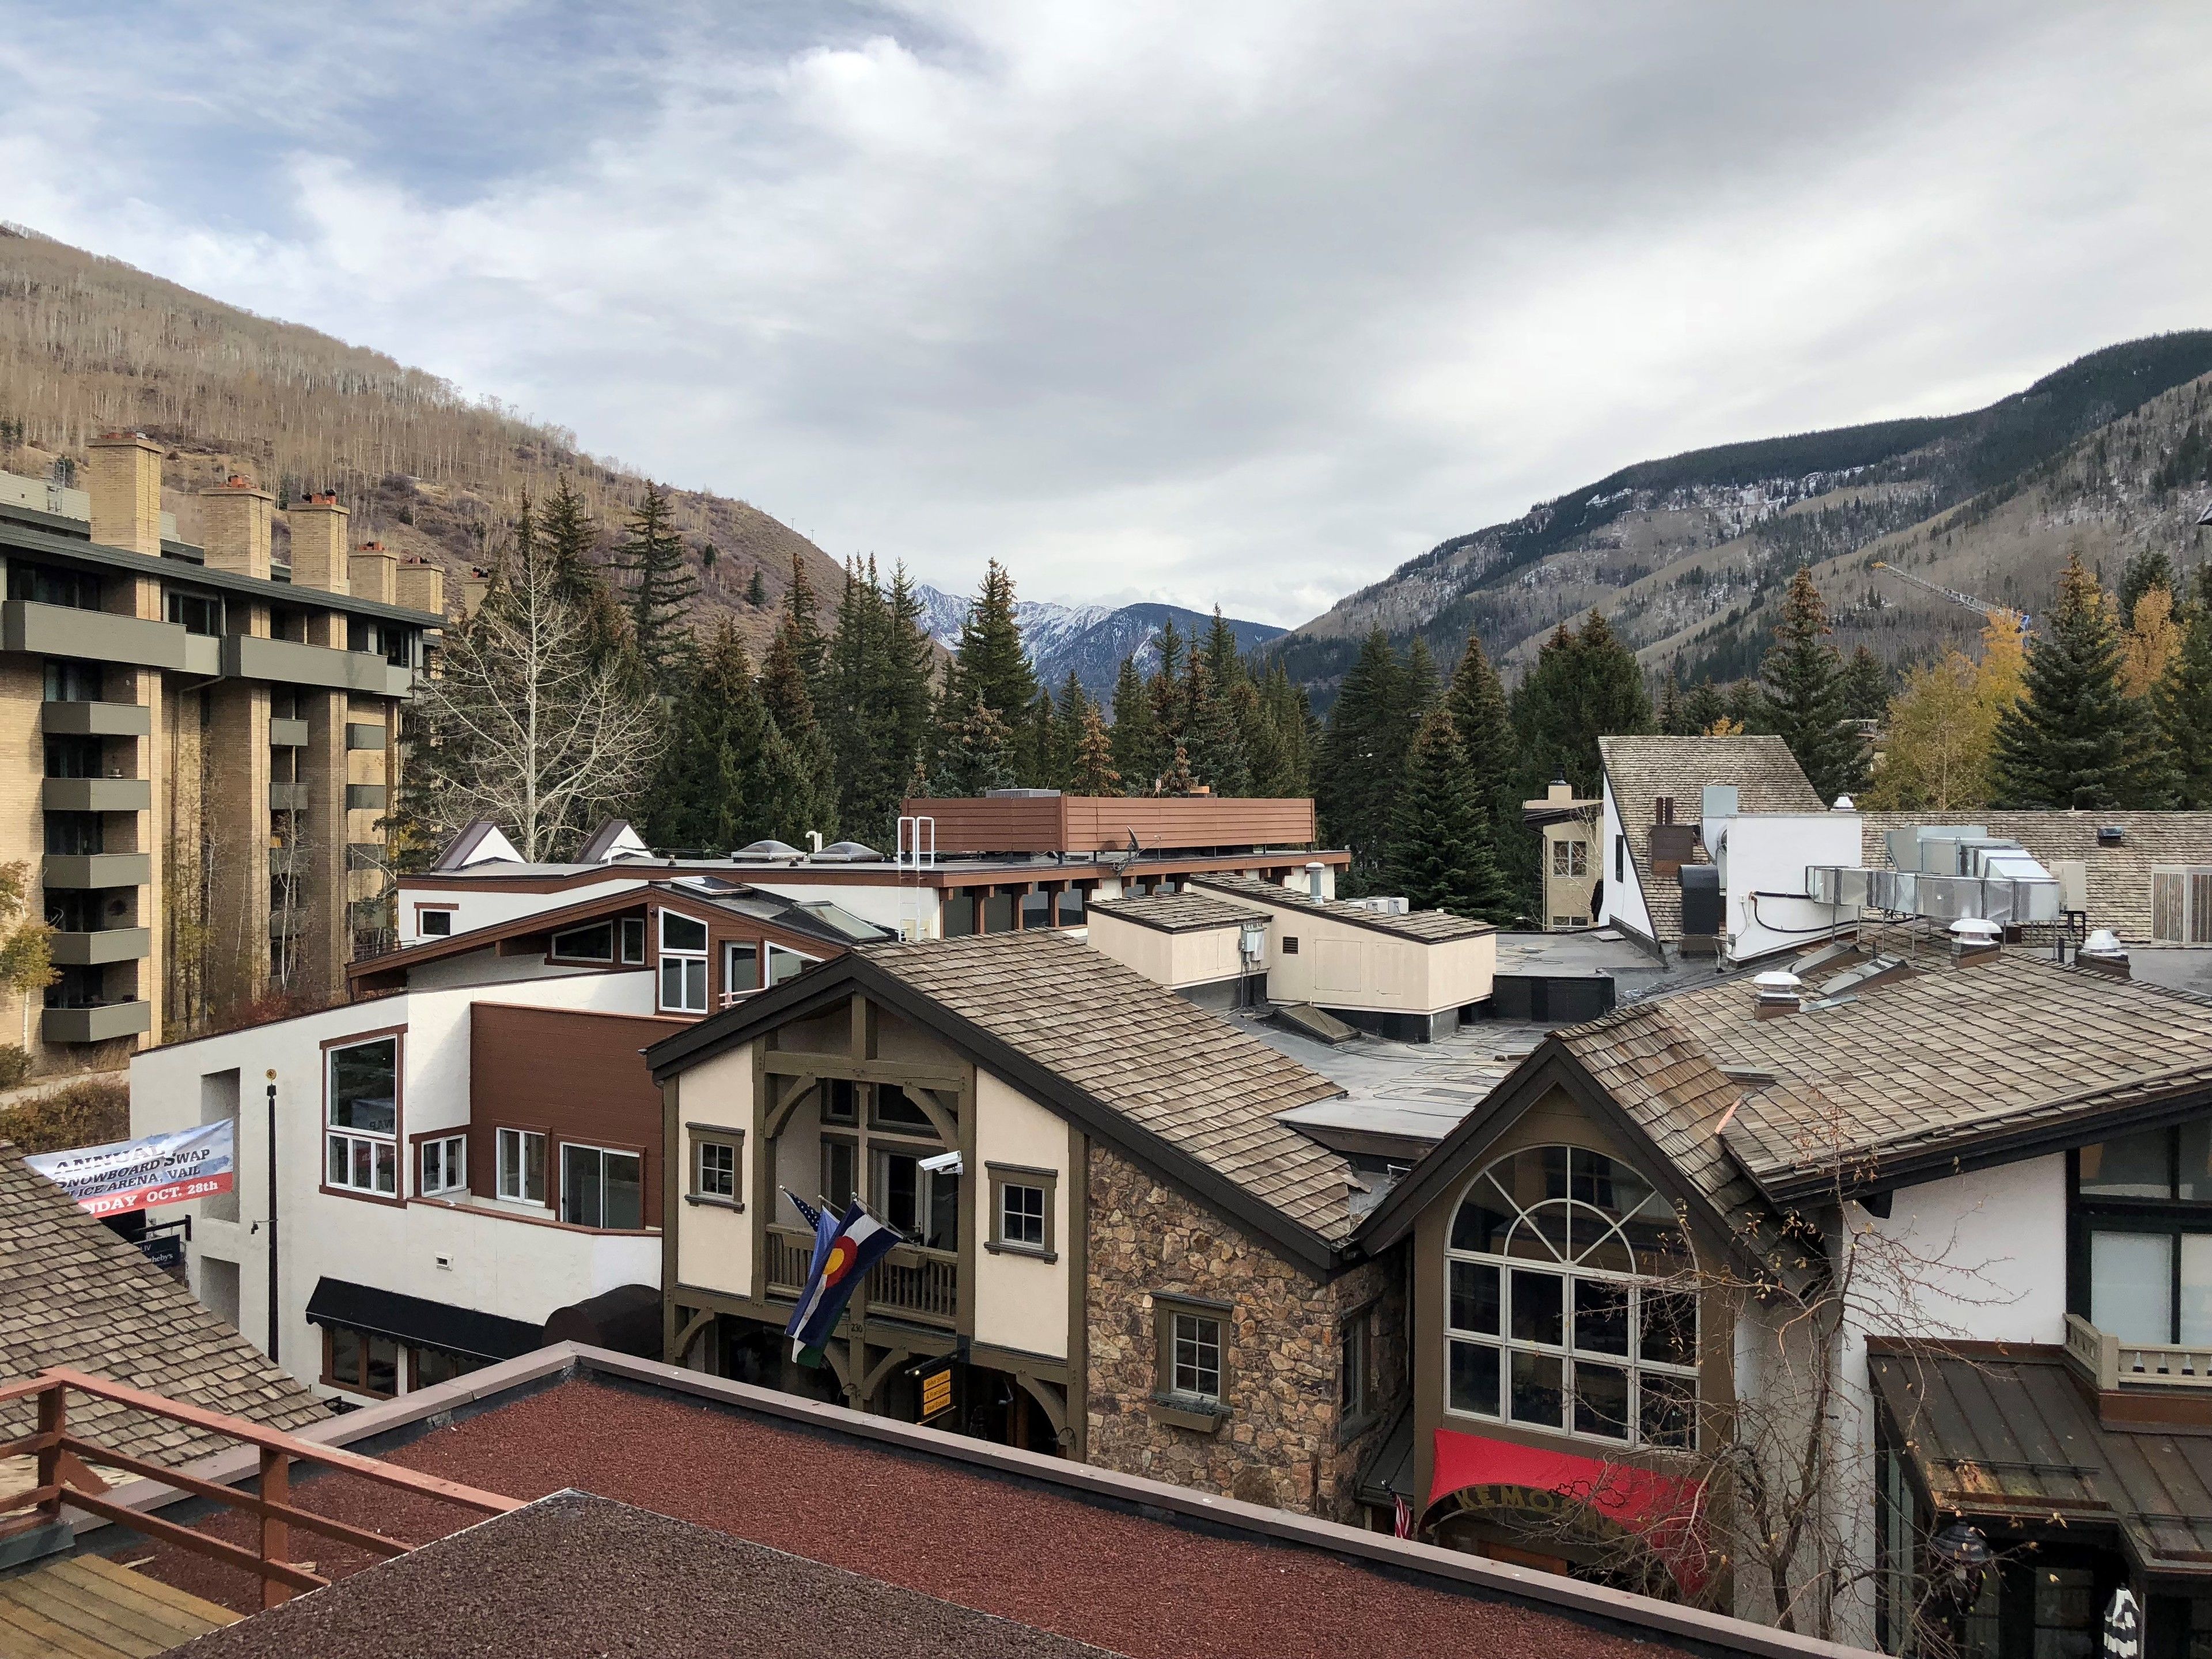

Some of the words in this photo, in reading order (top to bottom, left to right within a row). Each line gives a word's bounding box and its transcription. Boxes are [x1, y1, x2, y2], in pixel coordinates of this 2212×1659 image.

[54, 1146, 165, 1175] ANNUAL
[55, 1160, 160, 1188] SNOWBOARD
[164, 1149, 210, 1167] SWAP
[77, 1184, 104, 1197] ICE
[107, 1173, 163, 1191] ARENA,
[167, 1165, 200, 1180] VAIL
[79, 1195, 138, 1214] NDAY
[146, 1186, 183, 1203] OCT.
[187, 1180, 218, 1195] 28th
[1453, 1484, 1555, 1513] KEMO
